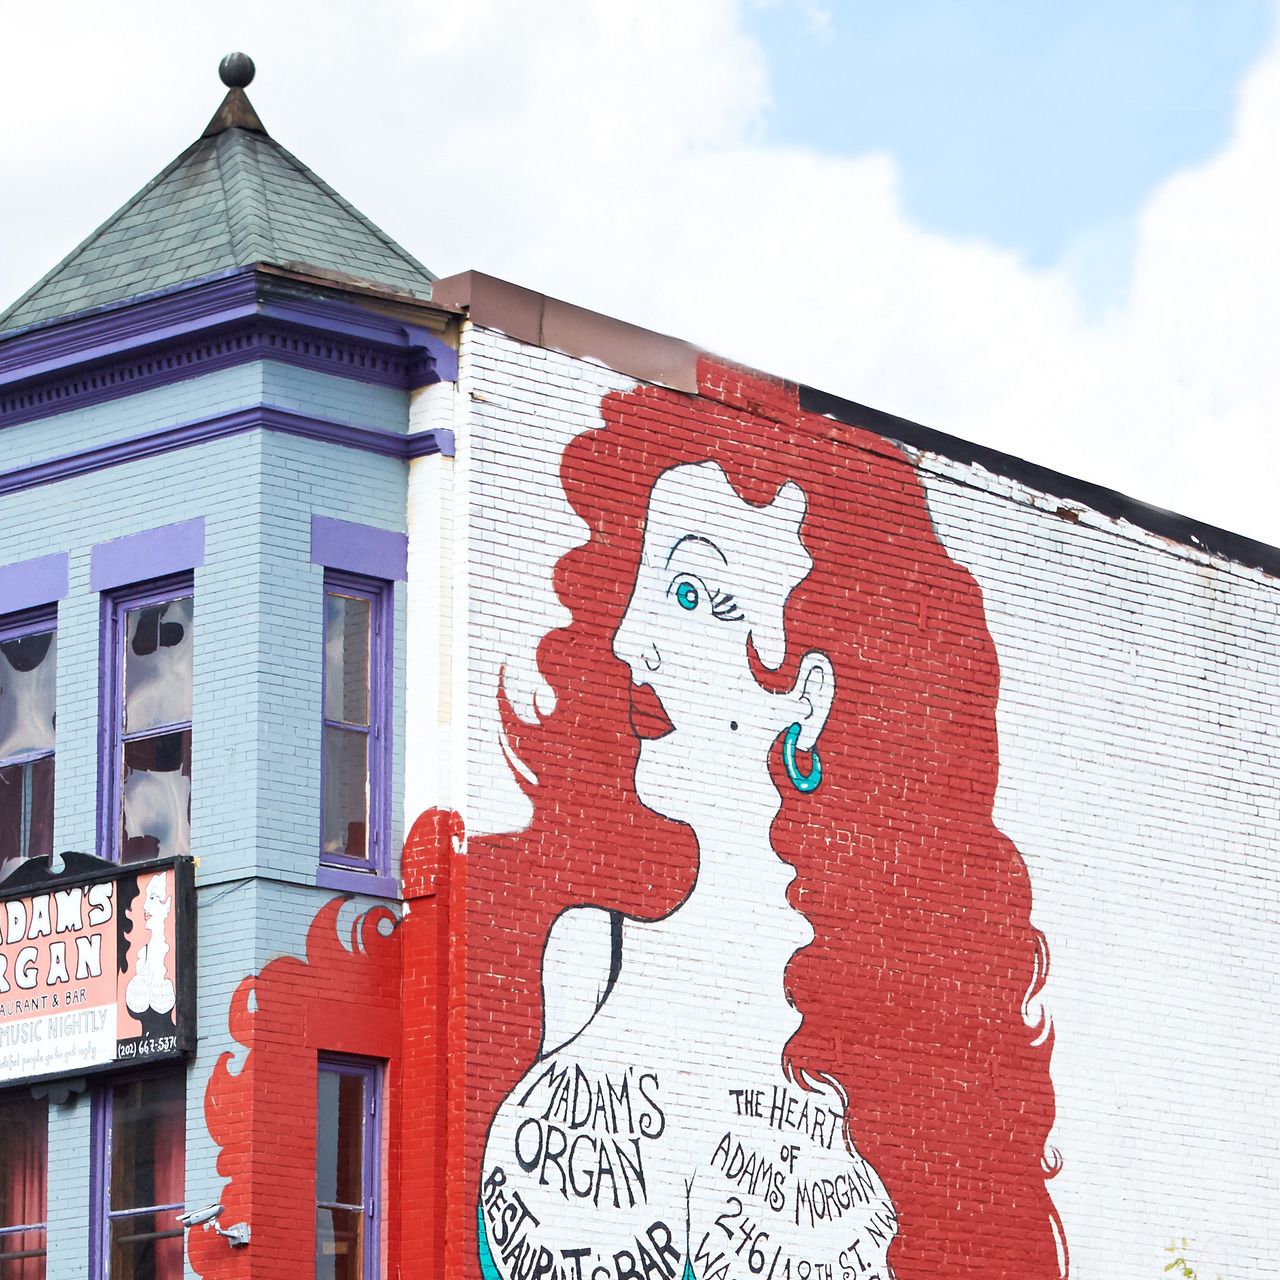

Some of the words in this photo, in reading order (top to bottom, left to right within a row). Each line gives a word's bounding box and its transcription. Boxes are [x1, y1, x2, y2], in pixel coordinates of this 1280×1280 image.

[52, 994, 59, 1007] &
[65, 988, 87, 1005] BAR
[0, 1018, 43, 1049] MUSIC
[47, 1009, 108, 1041] NIGHTLY
[118, 1041, 137, 1057] (202)
[517, 1060, 665, 1139] MADAM'S
[729, 1089, 765, 1118] THE
[770, 1085, 845, 1149] HEART
[515, 1117, 647, 1208] ORGAN
[711, 1131, 786, 1212] ADAMS
[795, 1160, 878, 1228] MORGAN
[780, 1145, 800, 1174] OF
[864, 1202, 898, 1248] NW
